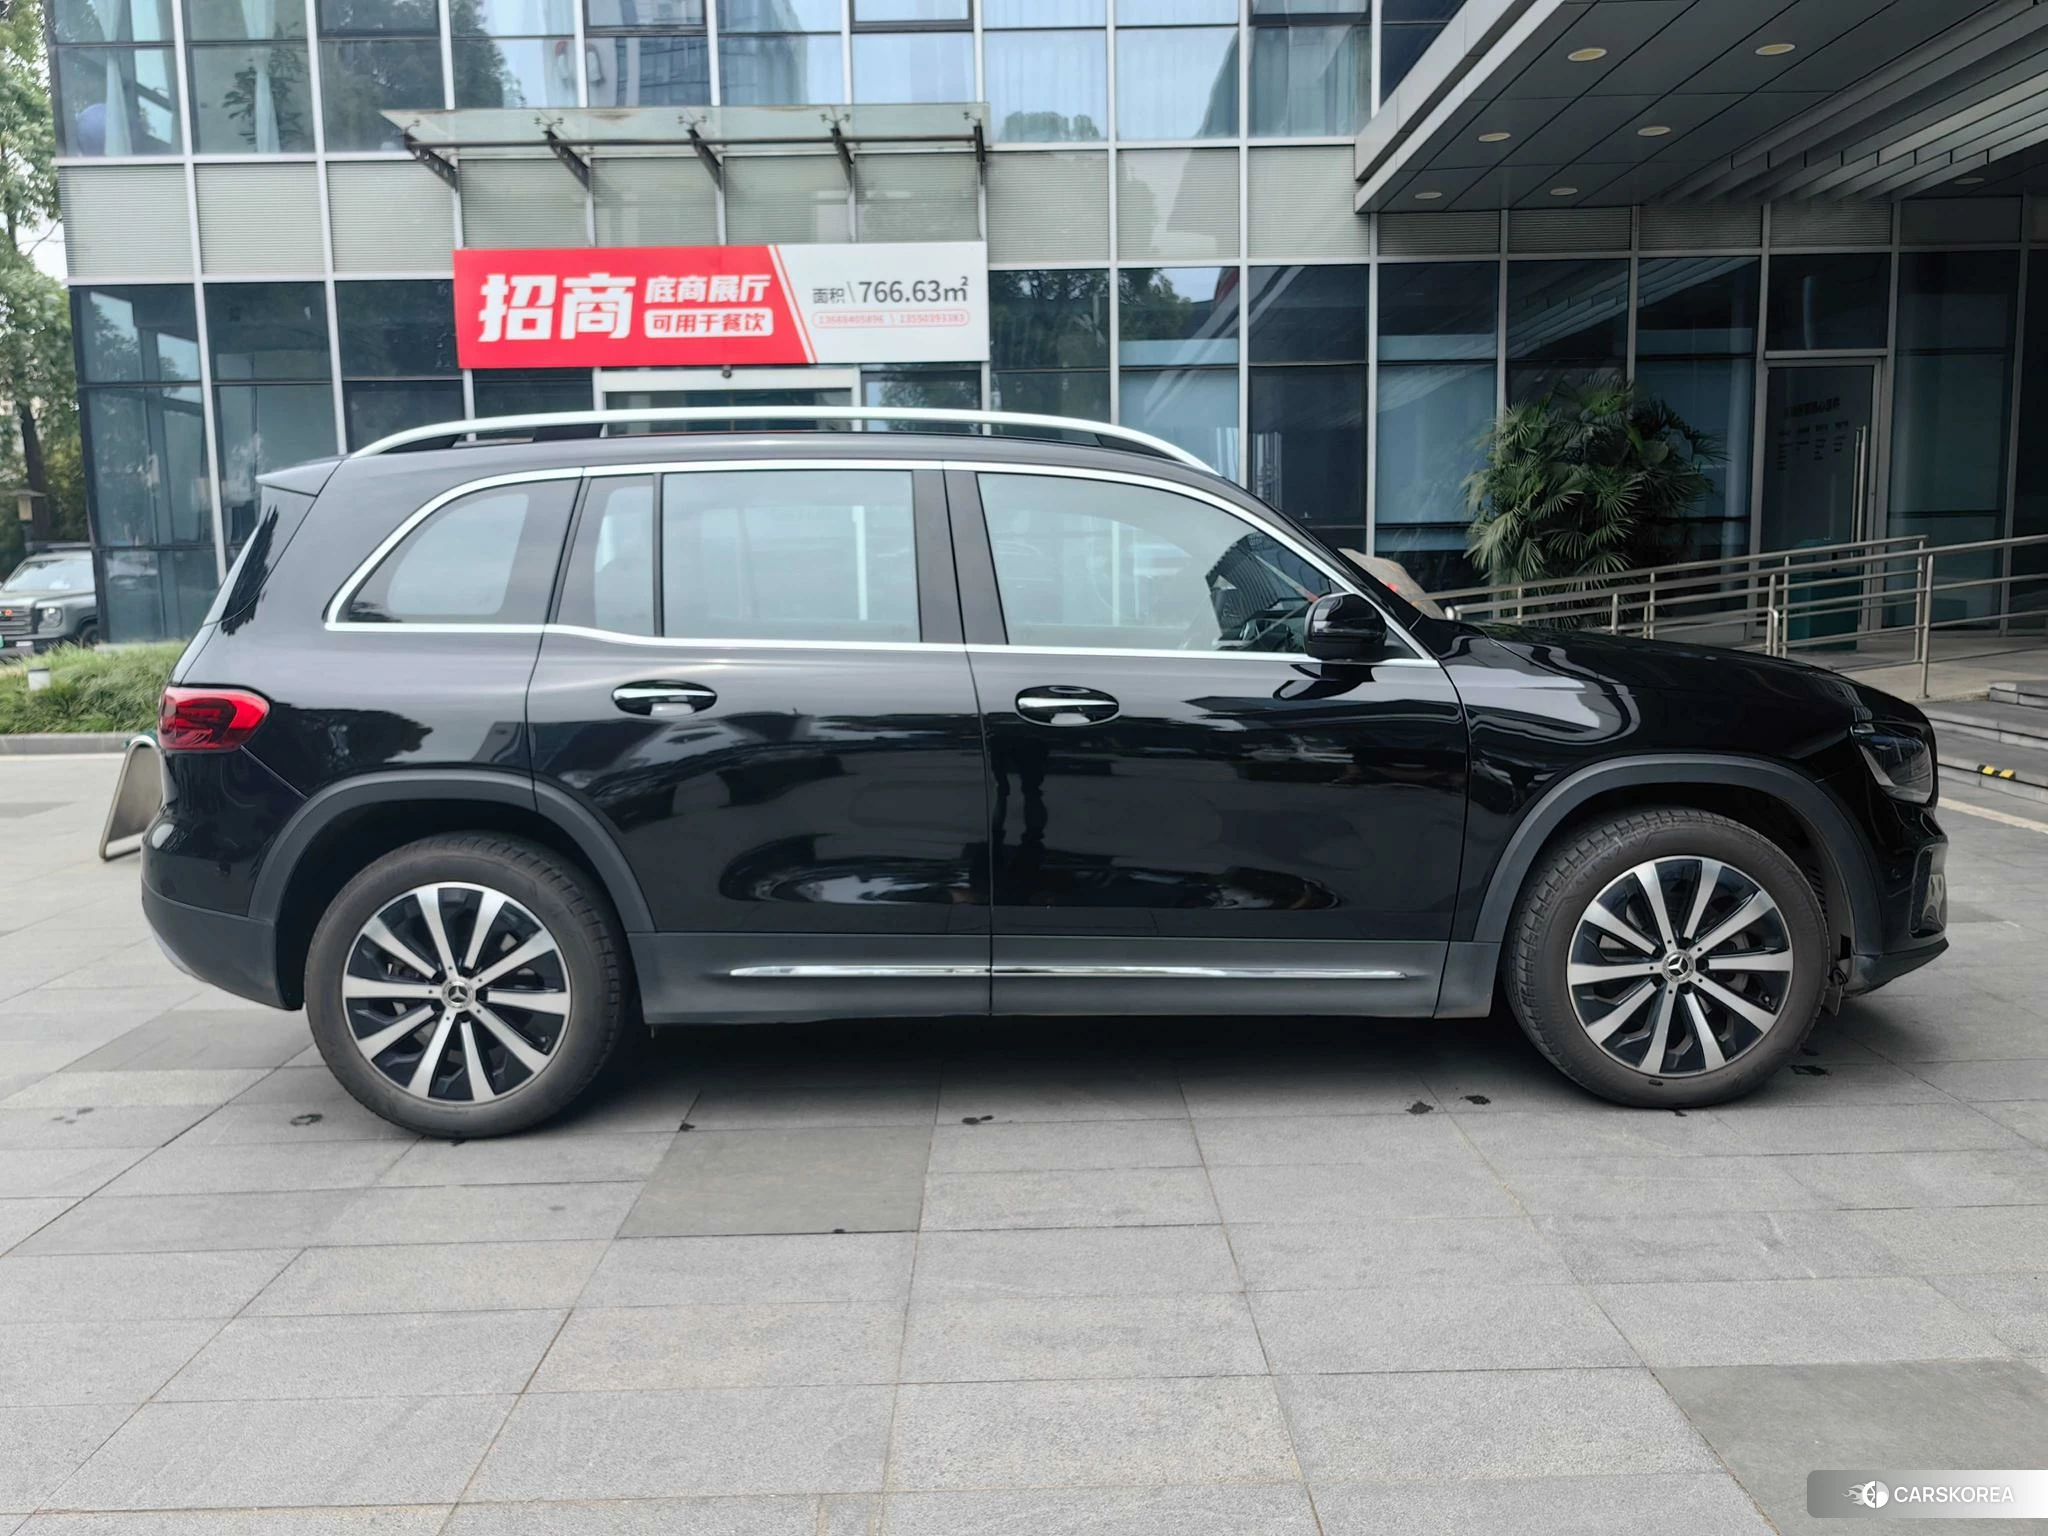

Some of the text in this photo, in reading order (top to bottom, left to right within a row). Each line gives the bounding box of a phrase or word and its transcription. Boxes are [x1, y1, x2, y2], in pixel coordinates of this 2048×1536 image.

[644, 273, 772, 304] 底商展厅
[812, 287, 846, 304] 面积
[478, 272, 636, 342] 招商
[651, 312, 766, 333] 可用于餐饮
